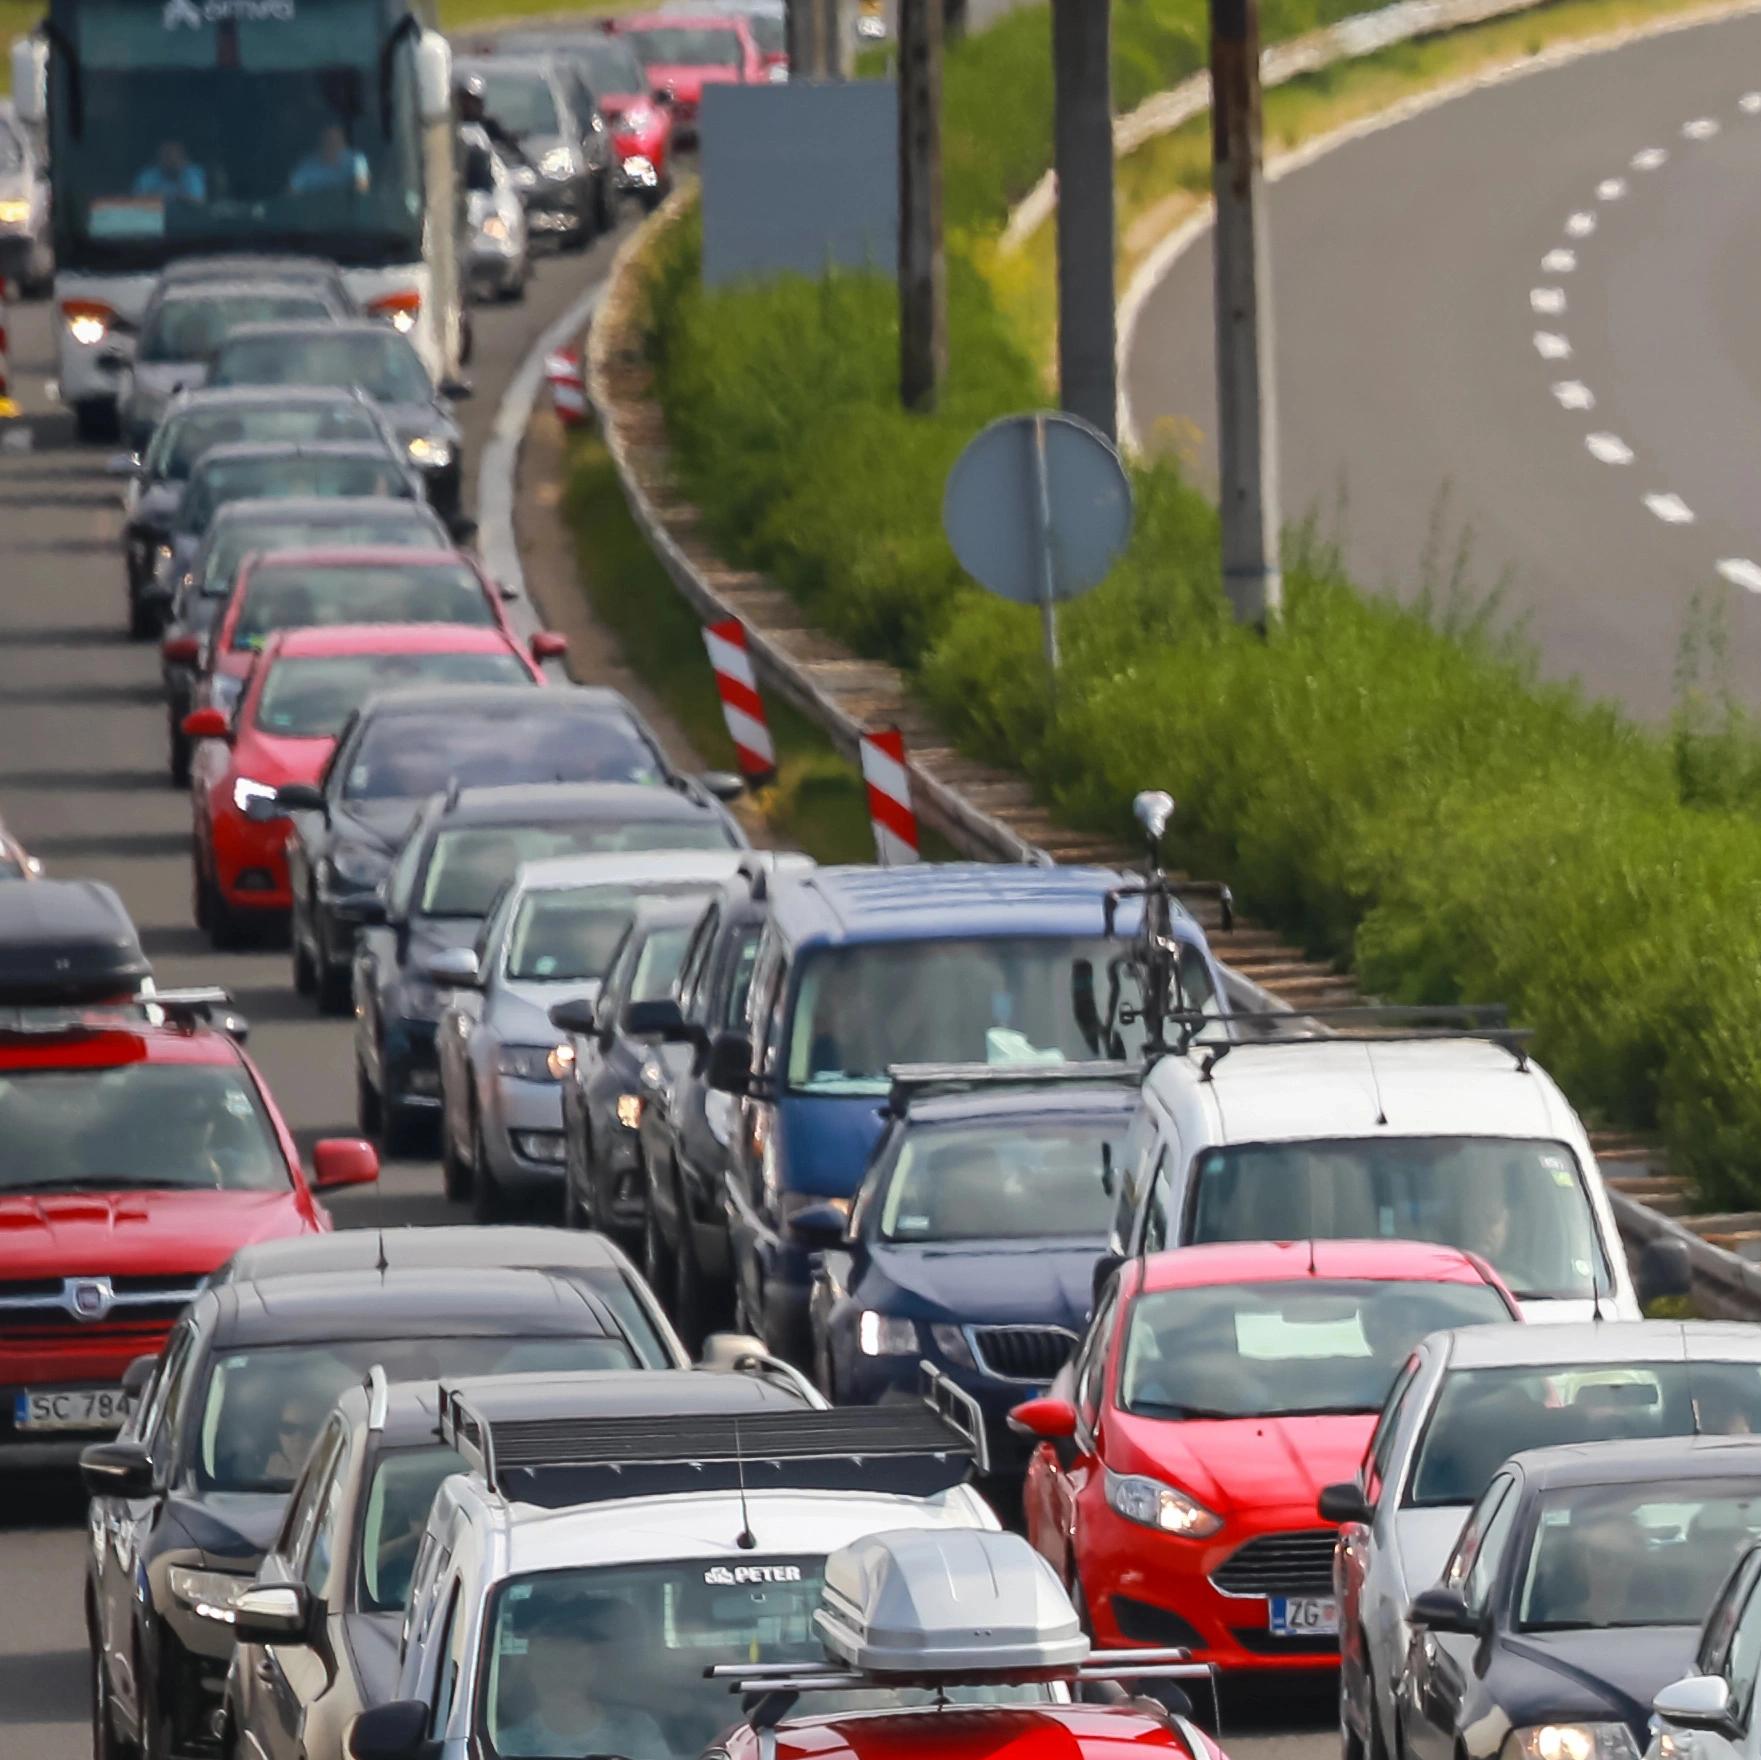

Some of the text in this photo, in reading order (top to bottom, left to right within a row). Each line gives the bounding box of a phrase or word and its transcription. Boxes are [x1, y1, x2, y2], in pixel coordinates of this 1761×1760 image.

[32, 1397, 69, 1420] SC
[734, 1566, 801, 1583] PETER
[1290, 1600, 1319, 1627] ZG
